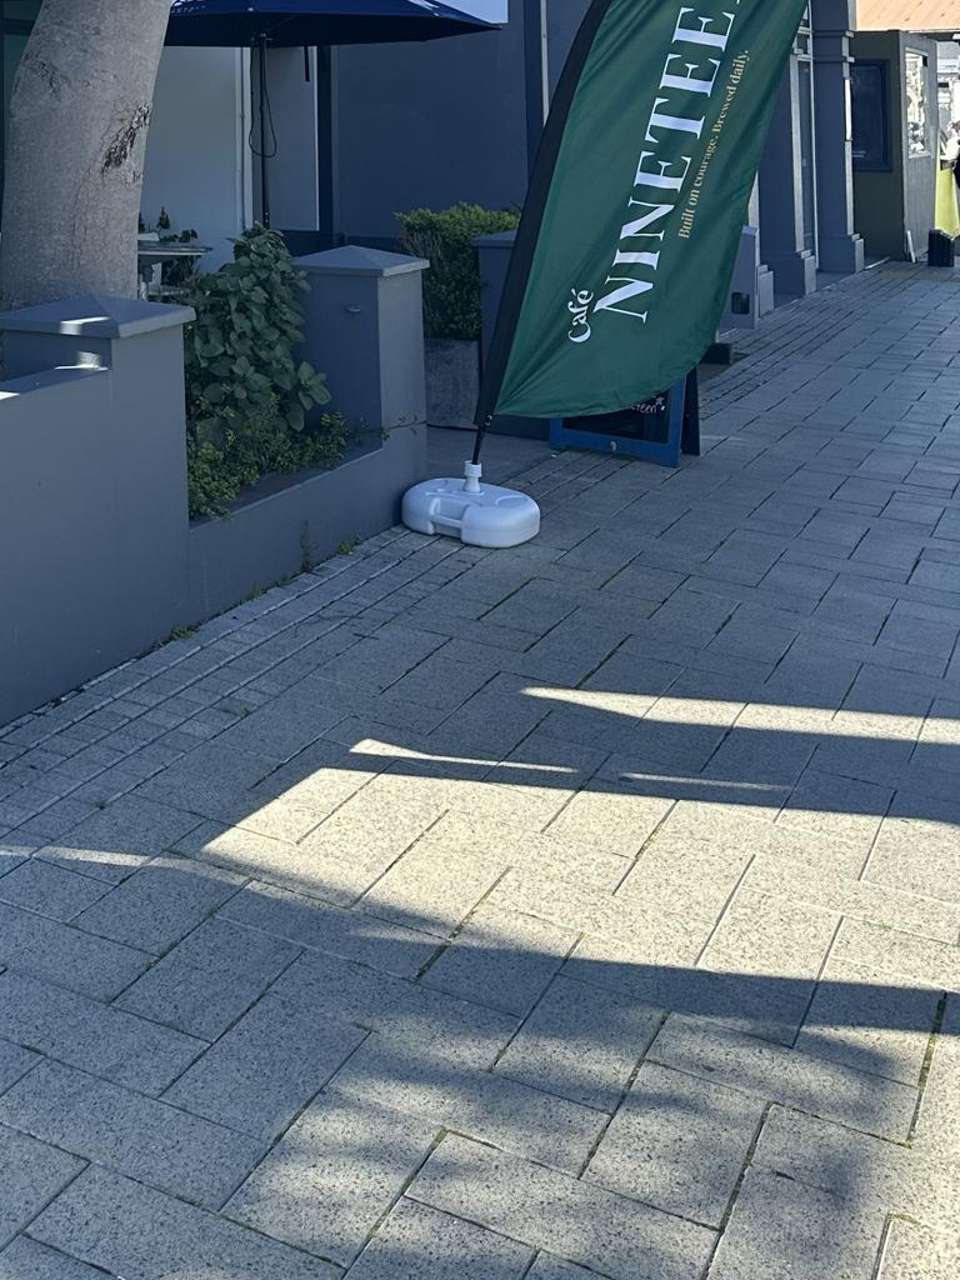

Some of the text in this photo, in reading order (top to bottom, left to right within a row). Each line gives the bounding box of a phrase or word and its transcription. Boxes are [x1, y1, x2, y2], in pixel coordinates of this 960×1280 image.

[678, 209, 696, 239] Built
[688, 189, 700, 206] on
[712, 85, 737, 133] Brewed
[729, 50, 751, 84] daily.
[568, 287, 595, 344] Café
